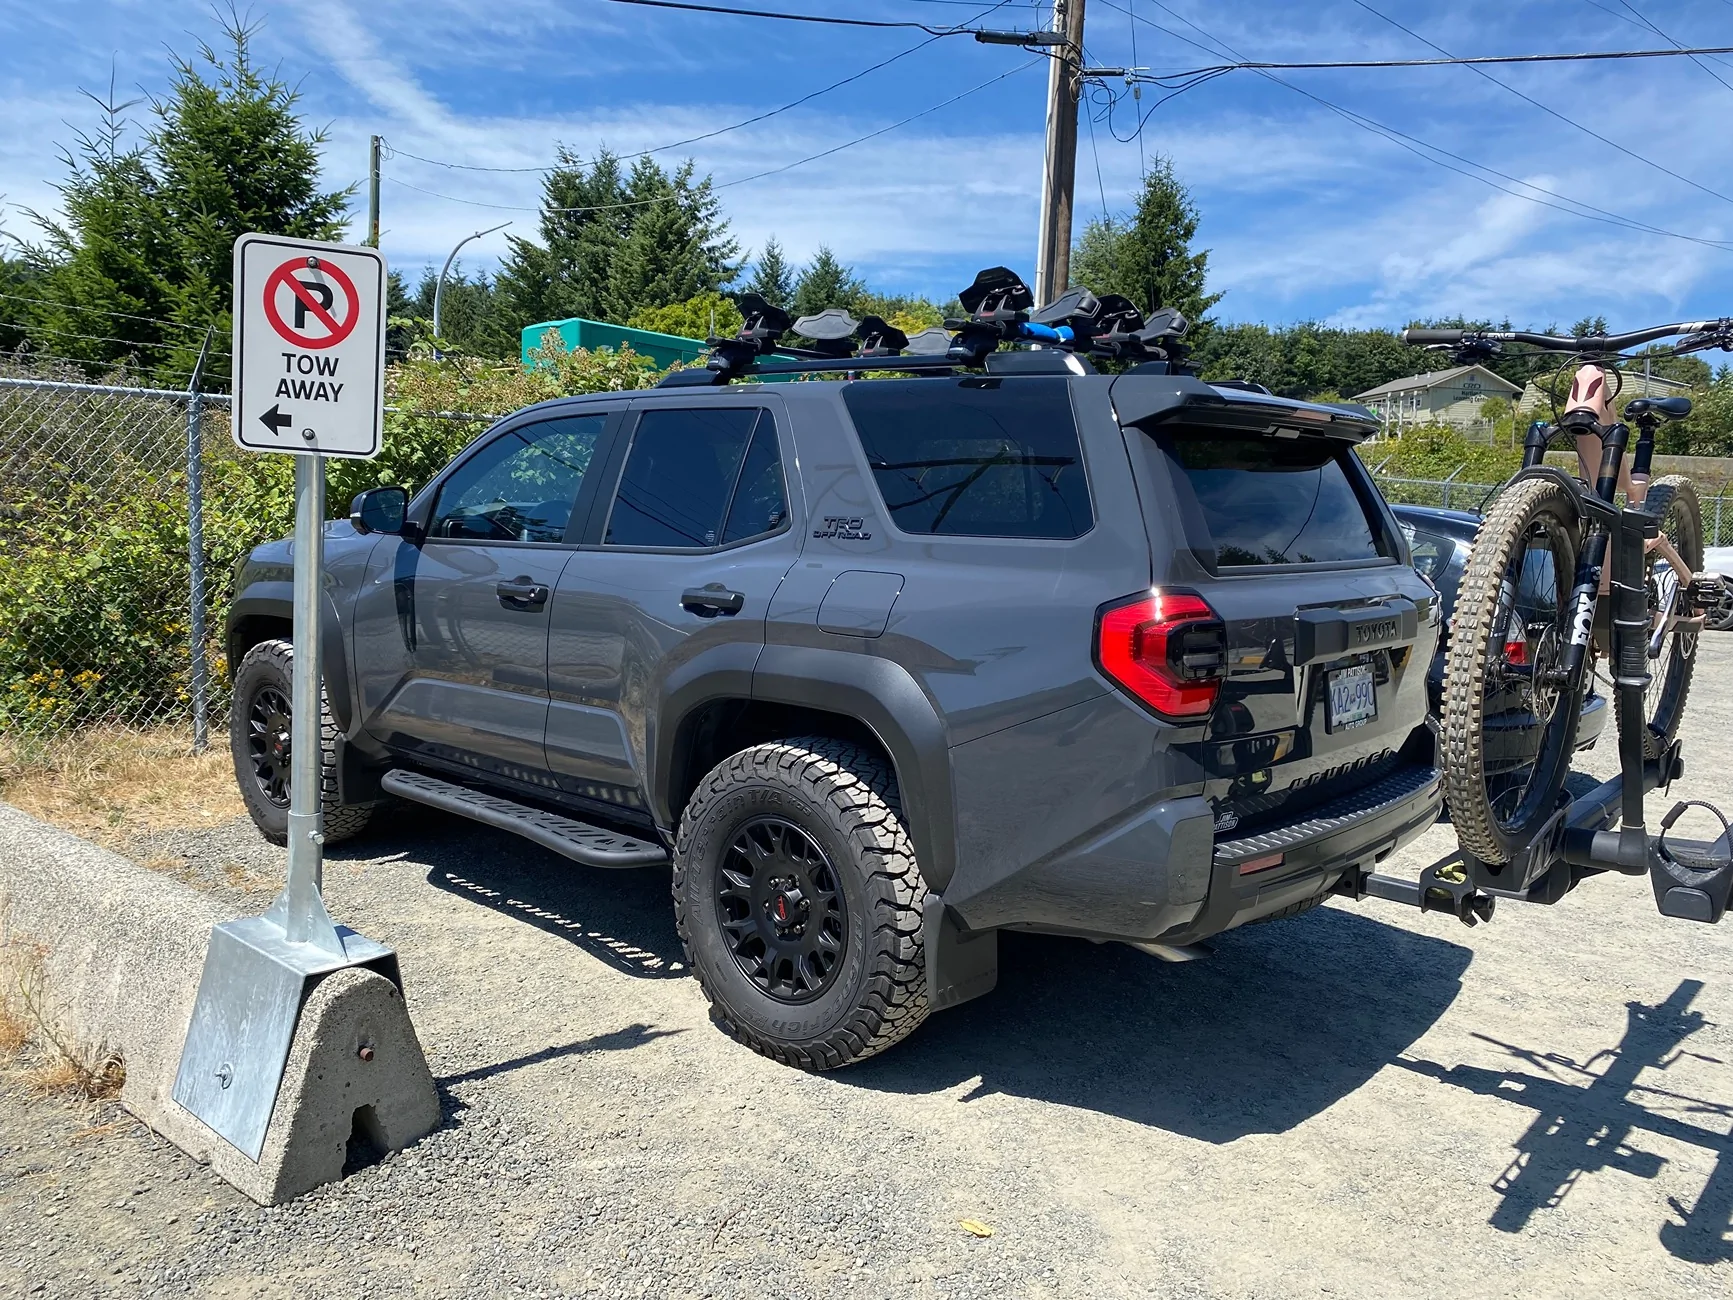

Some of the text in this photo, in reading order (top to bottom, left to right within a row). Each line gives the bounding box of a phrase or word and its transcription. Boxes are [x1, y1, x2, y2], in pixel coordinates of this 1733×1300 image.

[281, 352, 340, 377] TOW
[274, 378, 344, 403] AWAY
[813, 530, 872, 541] OFF ROAD
[823, 516, 864, 533] TRD
[1570, 591, 1596, 646] FOX
[1355, 620, 1398, 643] TOYOTA
[1331, 686, 1351, 717] KA2
[1355, 718, 1368, 729] GROUP
[778, 895, 786, 920] TRD
